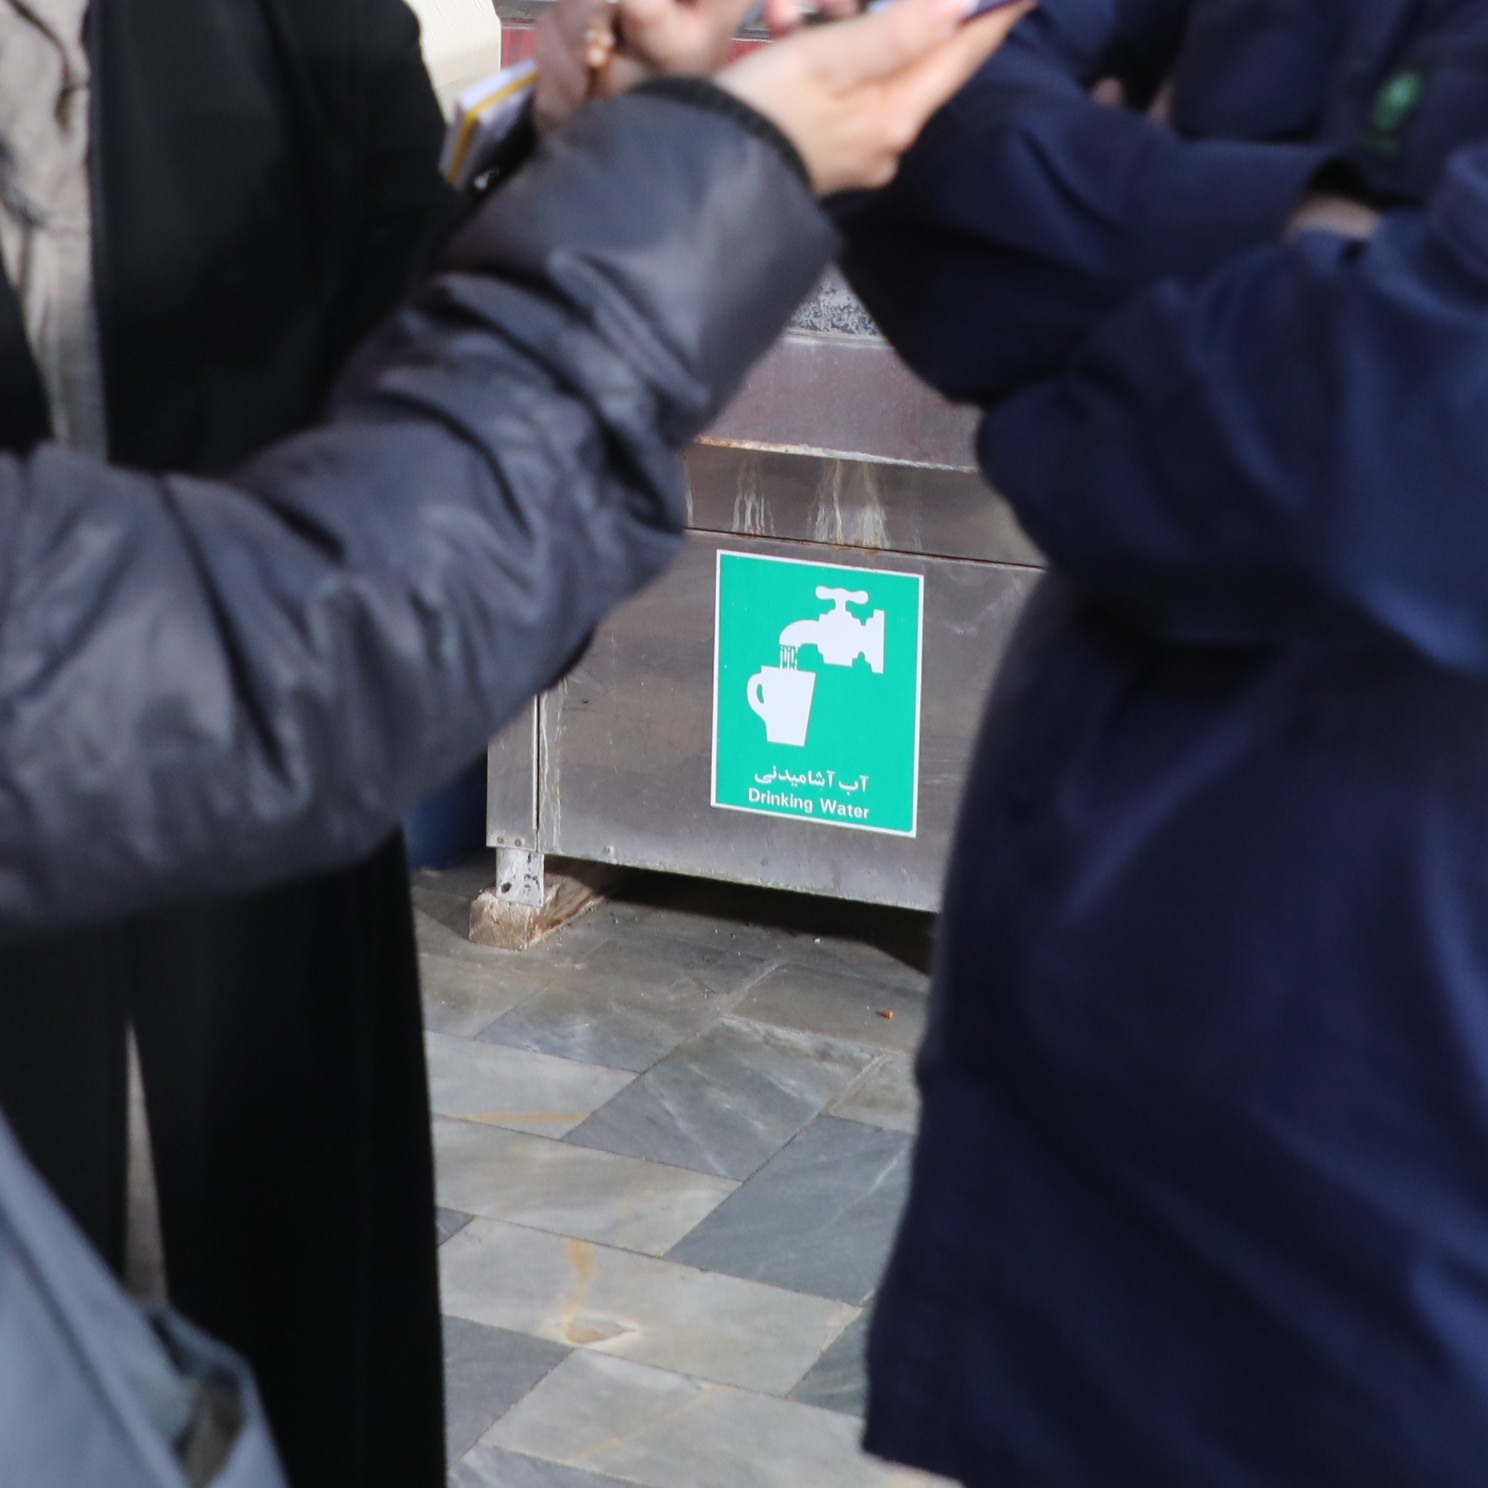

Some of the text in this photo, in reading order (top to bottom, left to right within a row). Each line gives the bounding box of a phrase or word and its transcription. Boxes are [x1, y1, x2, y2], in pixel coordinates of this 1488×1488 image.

[754, 765, 869, 797] آب آشامیدنی
[748, 787, 870, 819] Drinking Water
